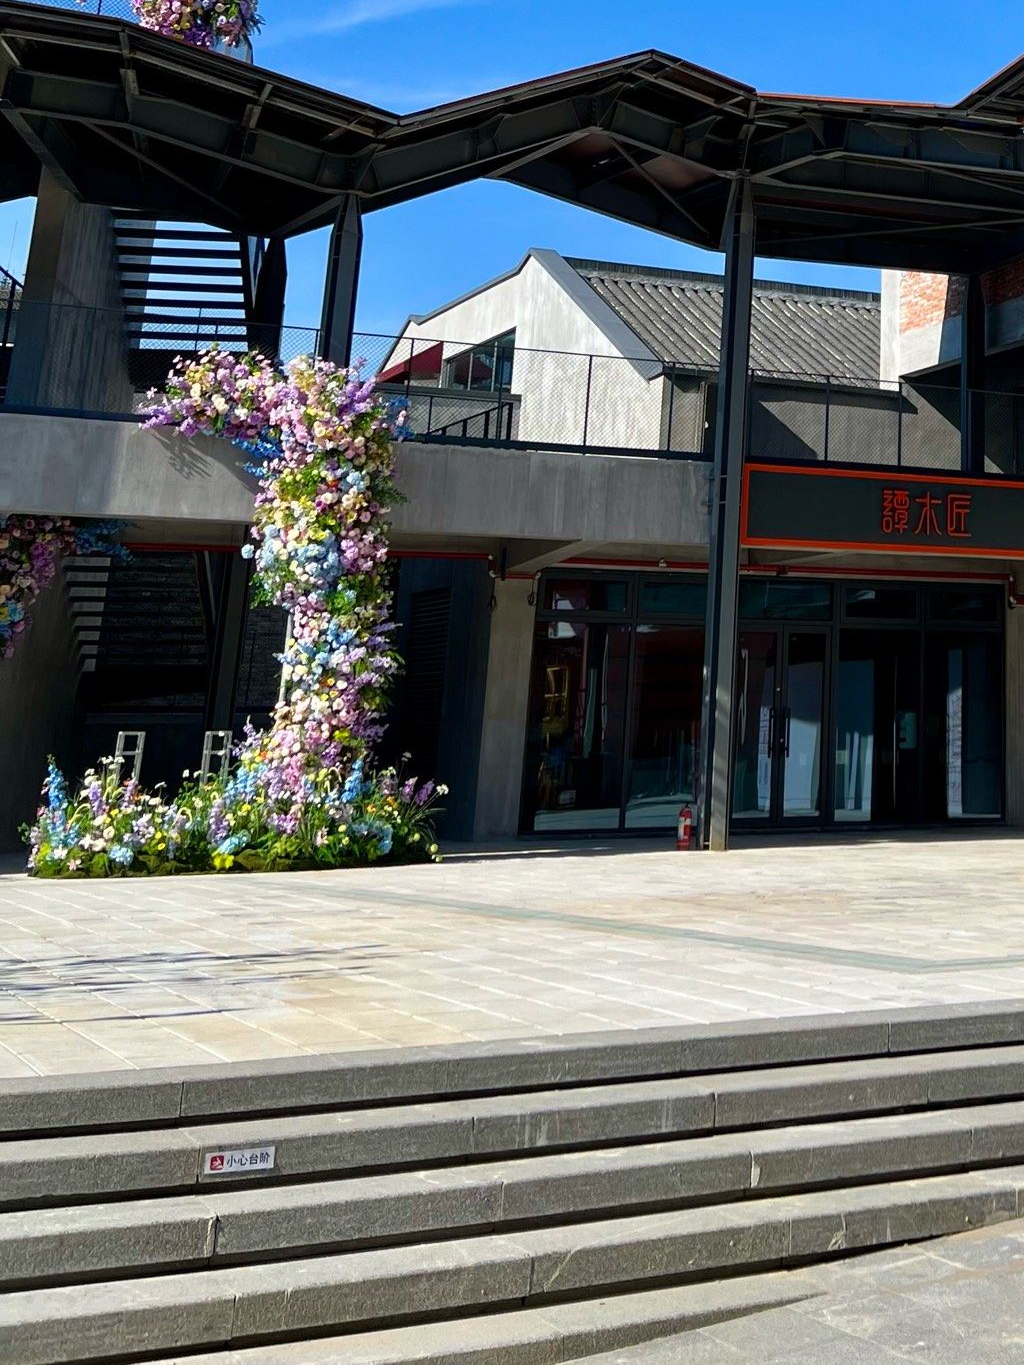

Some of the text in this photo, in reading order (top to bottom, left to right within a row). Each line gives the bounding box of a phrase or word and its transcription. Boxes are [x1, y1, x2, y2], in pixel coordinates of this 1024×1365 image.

[882, 488, 972, 537] 譚木匠
[226, 1152, 271, 1168] 小心台阶
